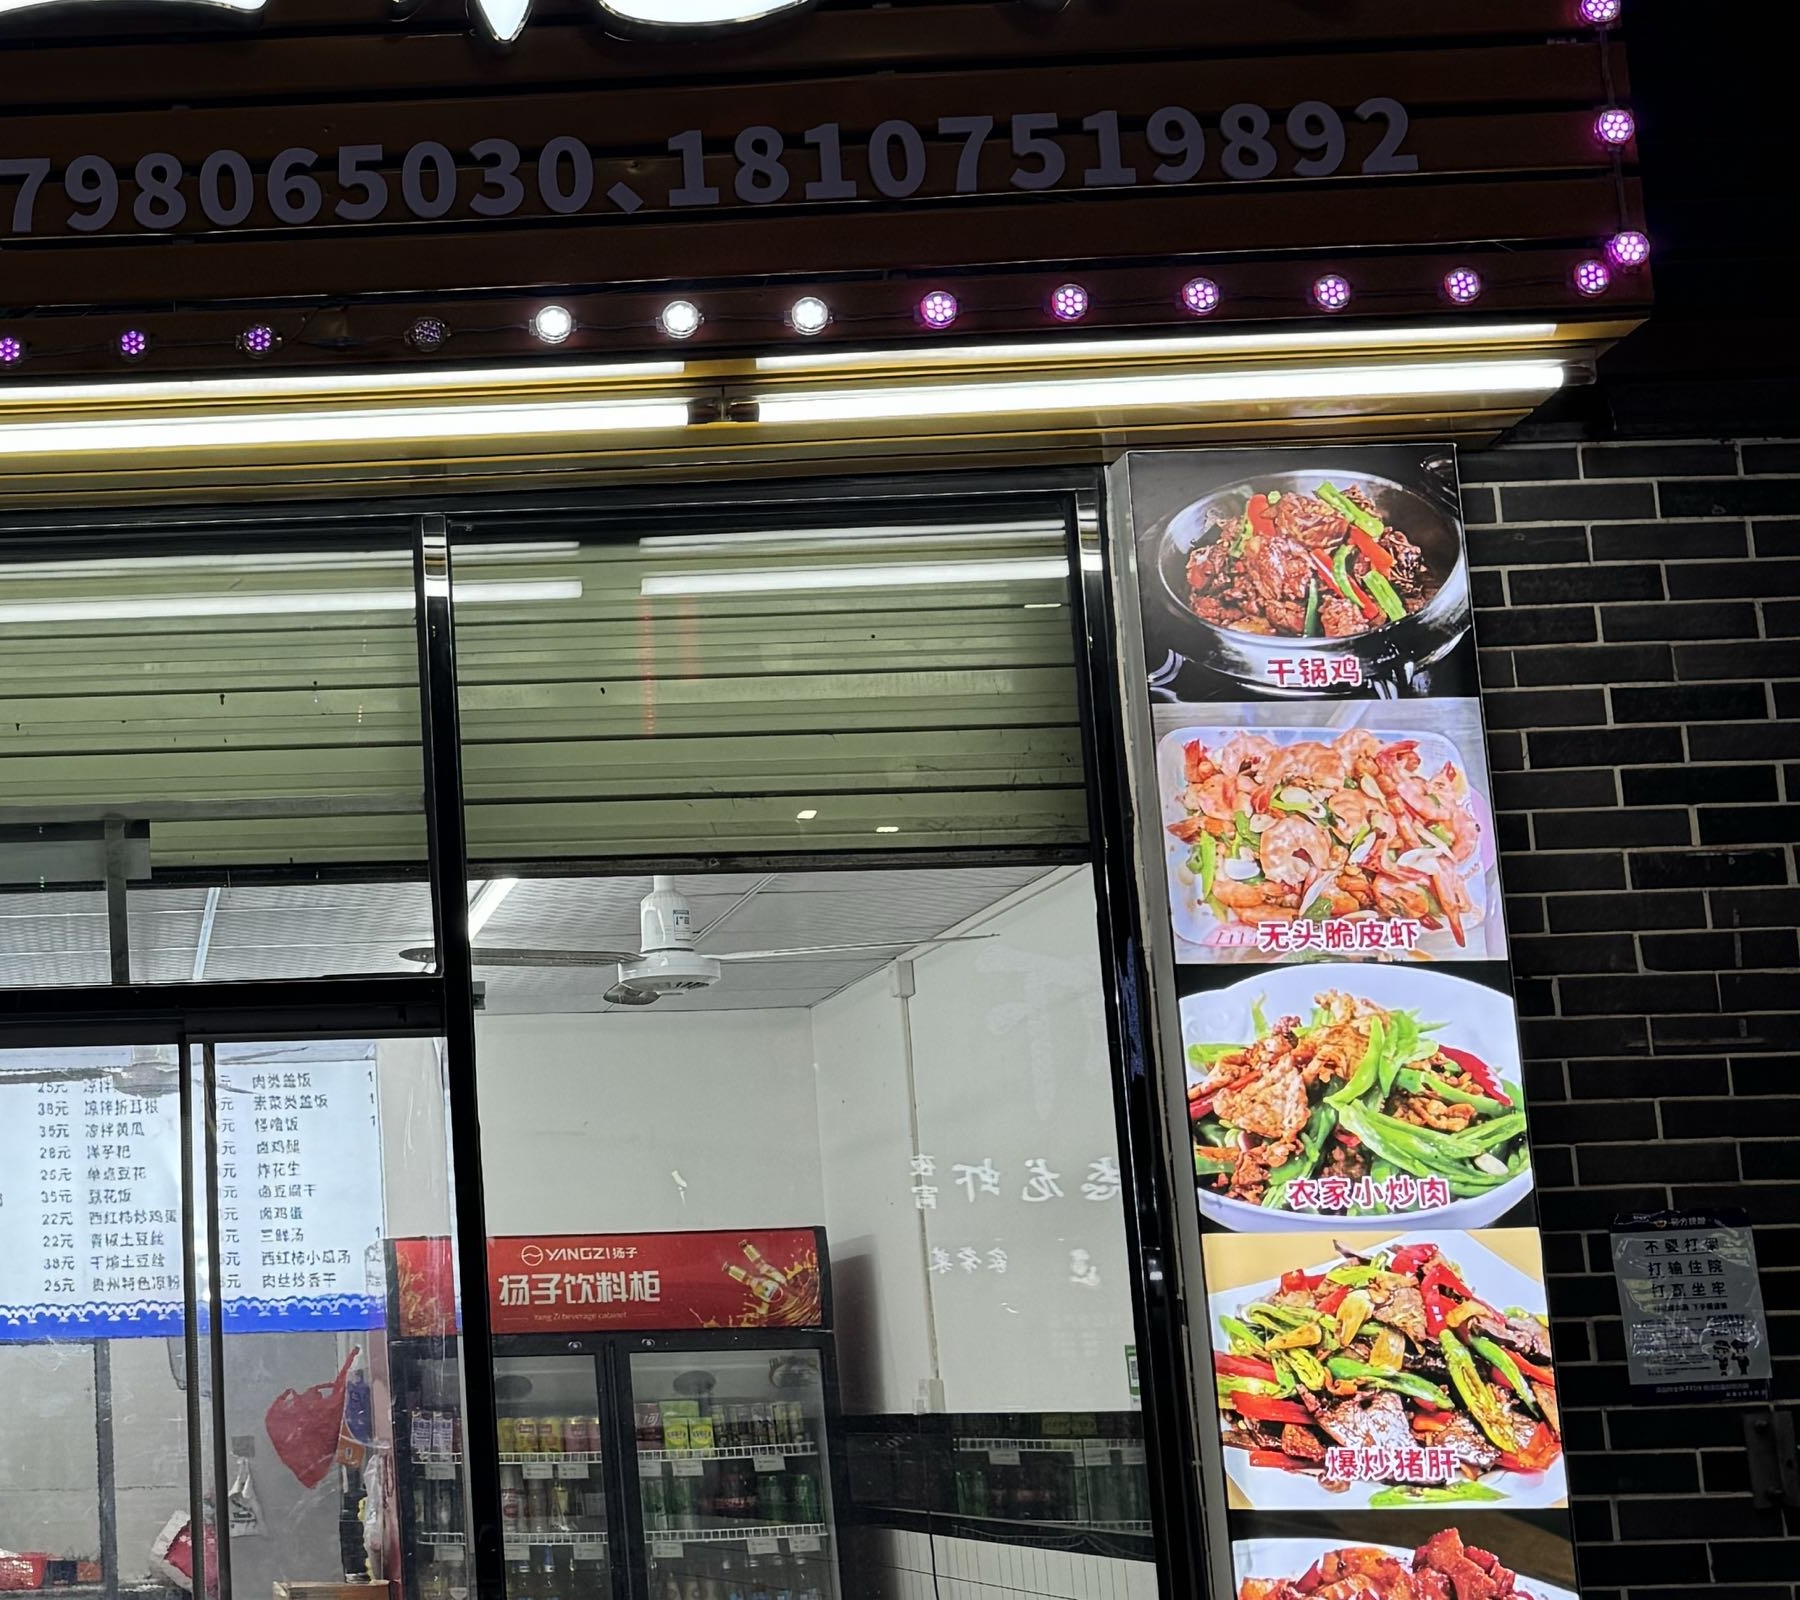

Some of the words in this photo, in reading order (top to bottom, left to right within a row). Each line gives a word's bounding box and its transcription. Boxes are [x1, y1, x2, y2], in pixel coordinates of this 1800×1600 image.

[1265, 657, 1362, 687] 干锅鸡
[1258, 920, 1419, 952] 无头脆皮虾
[1288, 1176, 1450, 1209] 农家小炒肉
[546, 1247, 610, 1261] YANGZI
[613, 1247, 638, 1259] 扬子
[498, 1270, 661, 1306] 扬子饮料柜
[1325, 1446, 1459, 1482] 爆炒猪肝
